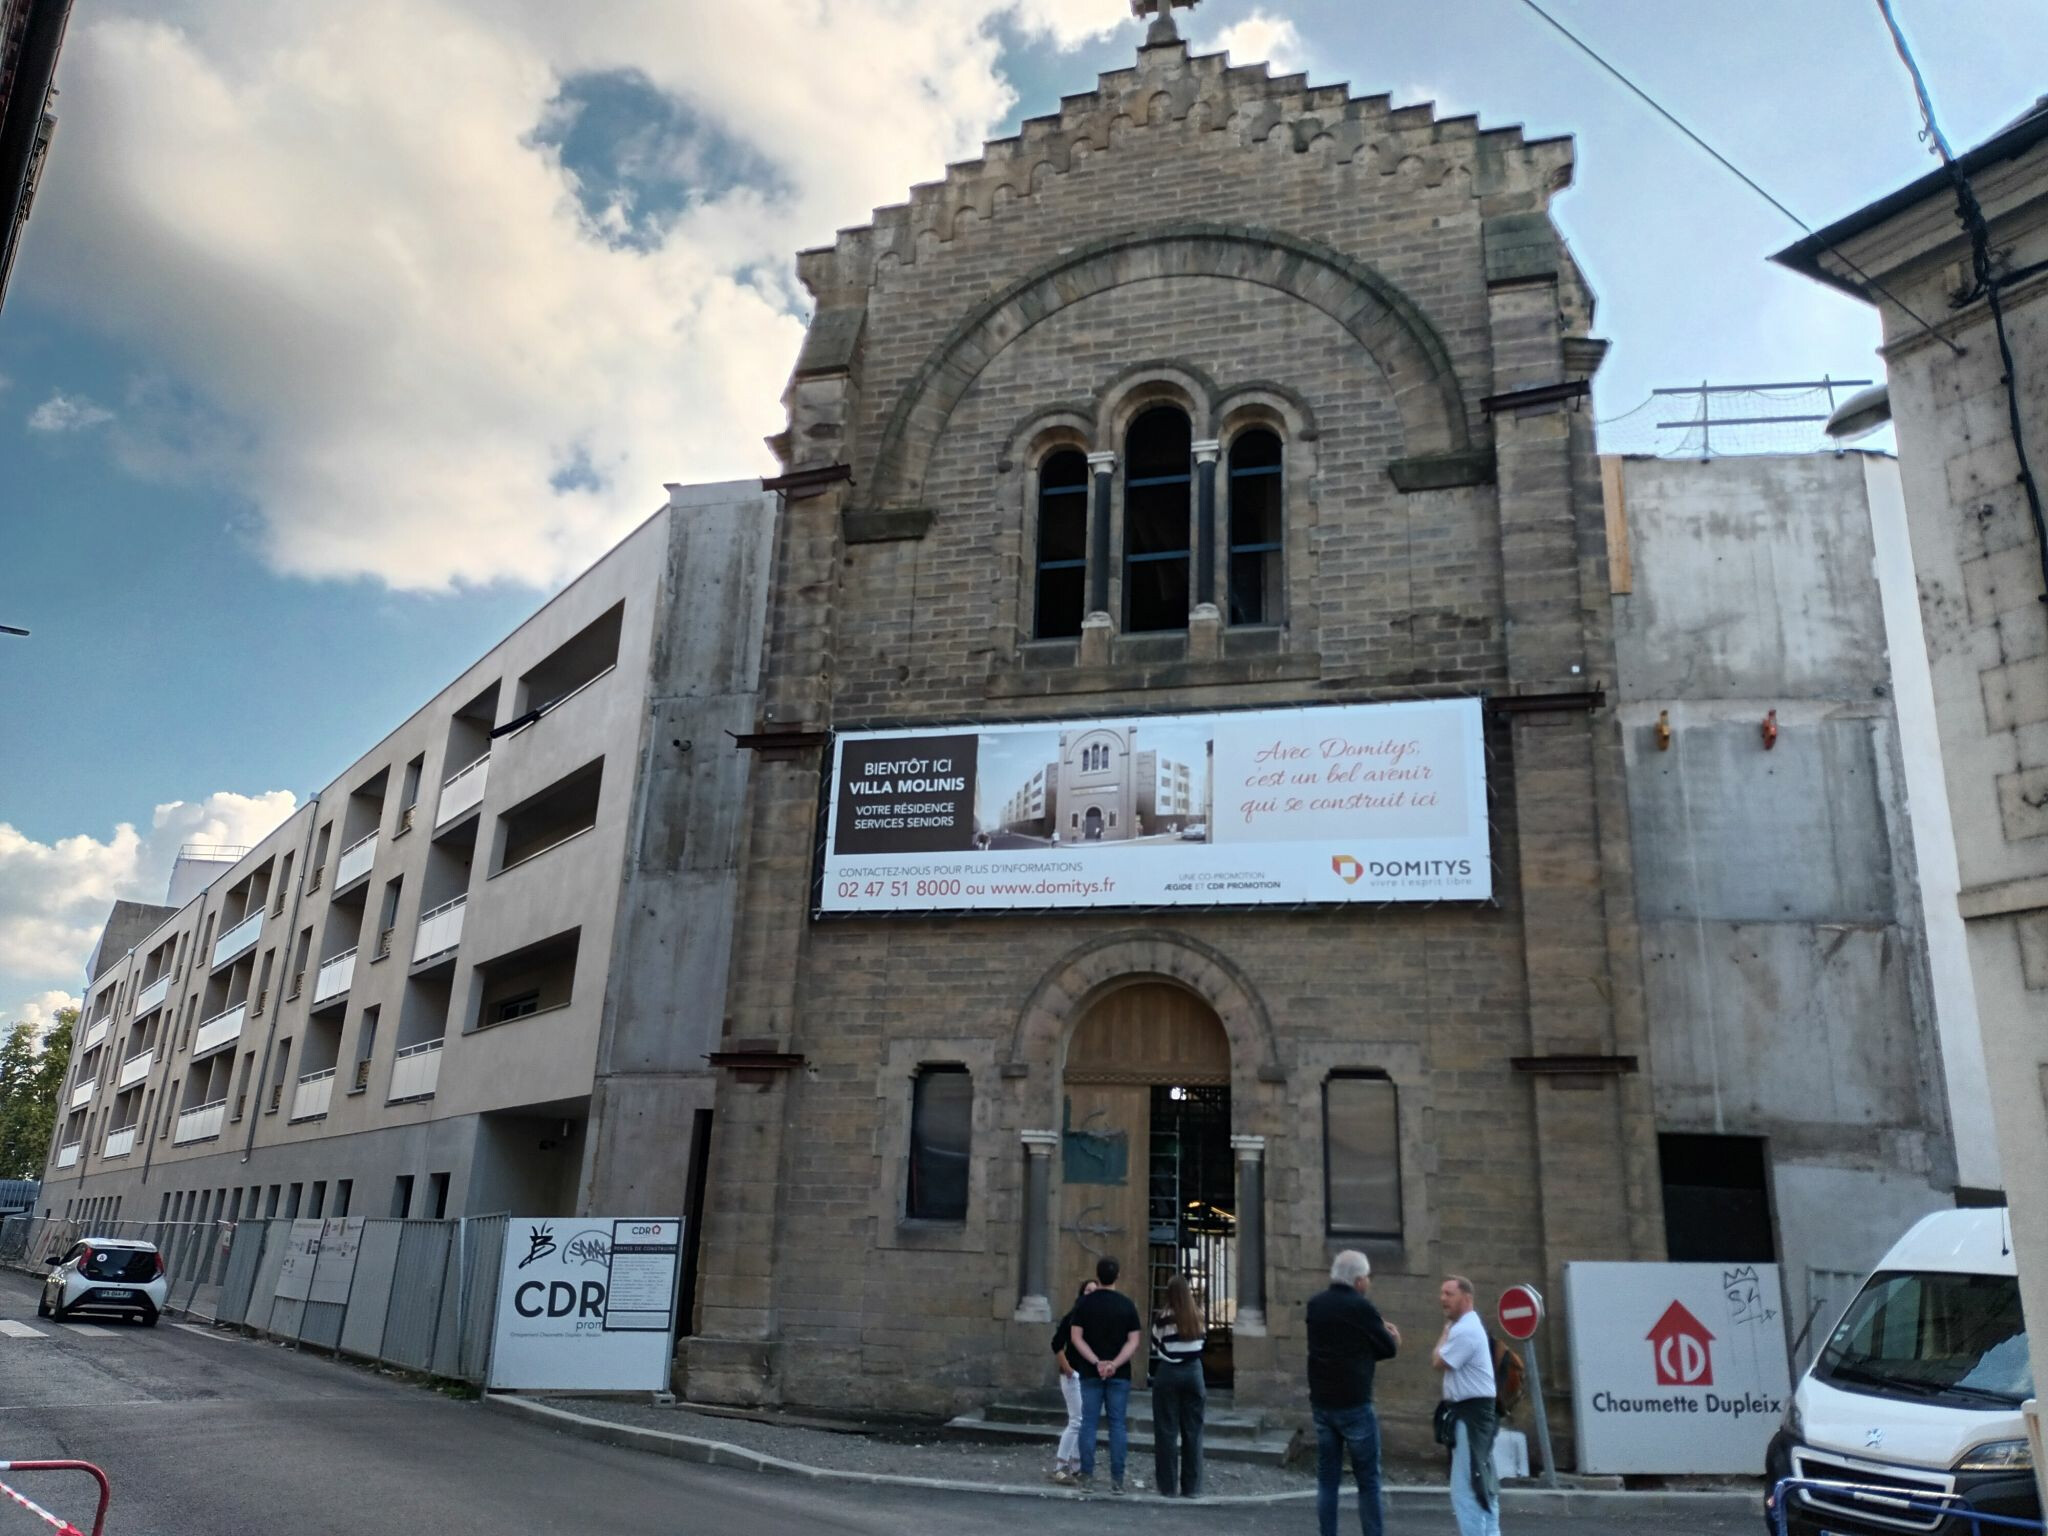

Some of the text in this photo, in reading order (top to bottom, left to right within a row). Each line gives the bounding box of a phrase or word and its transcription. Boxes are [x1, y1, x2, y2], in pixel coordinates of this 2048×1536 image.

[1254, 740, 1312, 763] Avec
[864, 758, 952, 776] BIENTÔT ICI
[1290, 772, 1319, 785] un
[1326, 762, 1363, 784] bel
[1362, 765, 1435, 782] avenir
[849, 777, 965, 795] VILLA MOLINIS
[856, 802, 955, 815] VOTRE RÉSIDENCE
[1240, 791, 1439, 824] qui se construit ici
[854, 816, 955, 829] SERVICES SENIORS
[840, 862, 1083, 877] CONTACTEZ-NOUS POUR PLUS D'INFORMATIONS
[1369, 859, 1472, 877] DOMITYS
[838, 876, 1115, 897] 02 47 51 8000 ou www.domitys.fr
[1227, 881, 1281, 889] PROMOTION
[632, 1226, 652, 1235] CDR
[514, 1281, 605, 1318] CDR
[1593, 1392, 1782, 1418] Chaumette Dupleix
